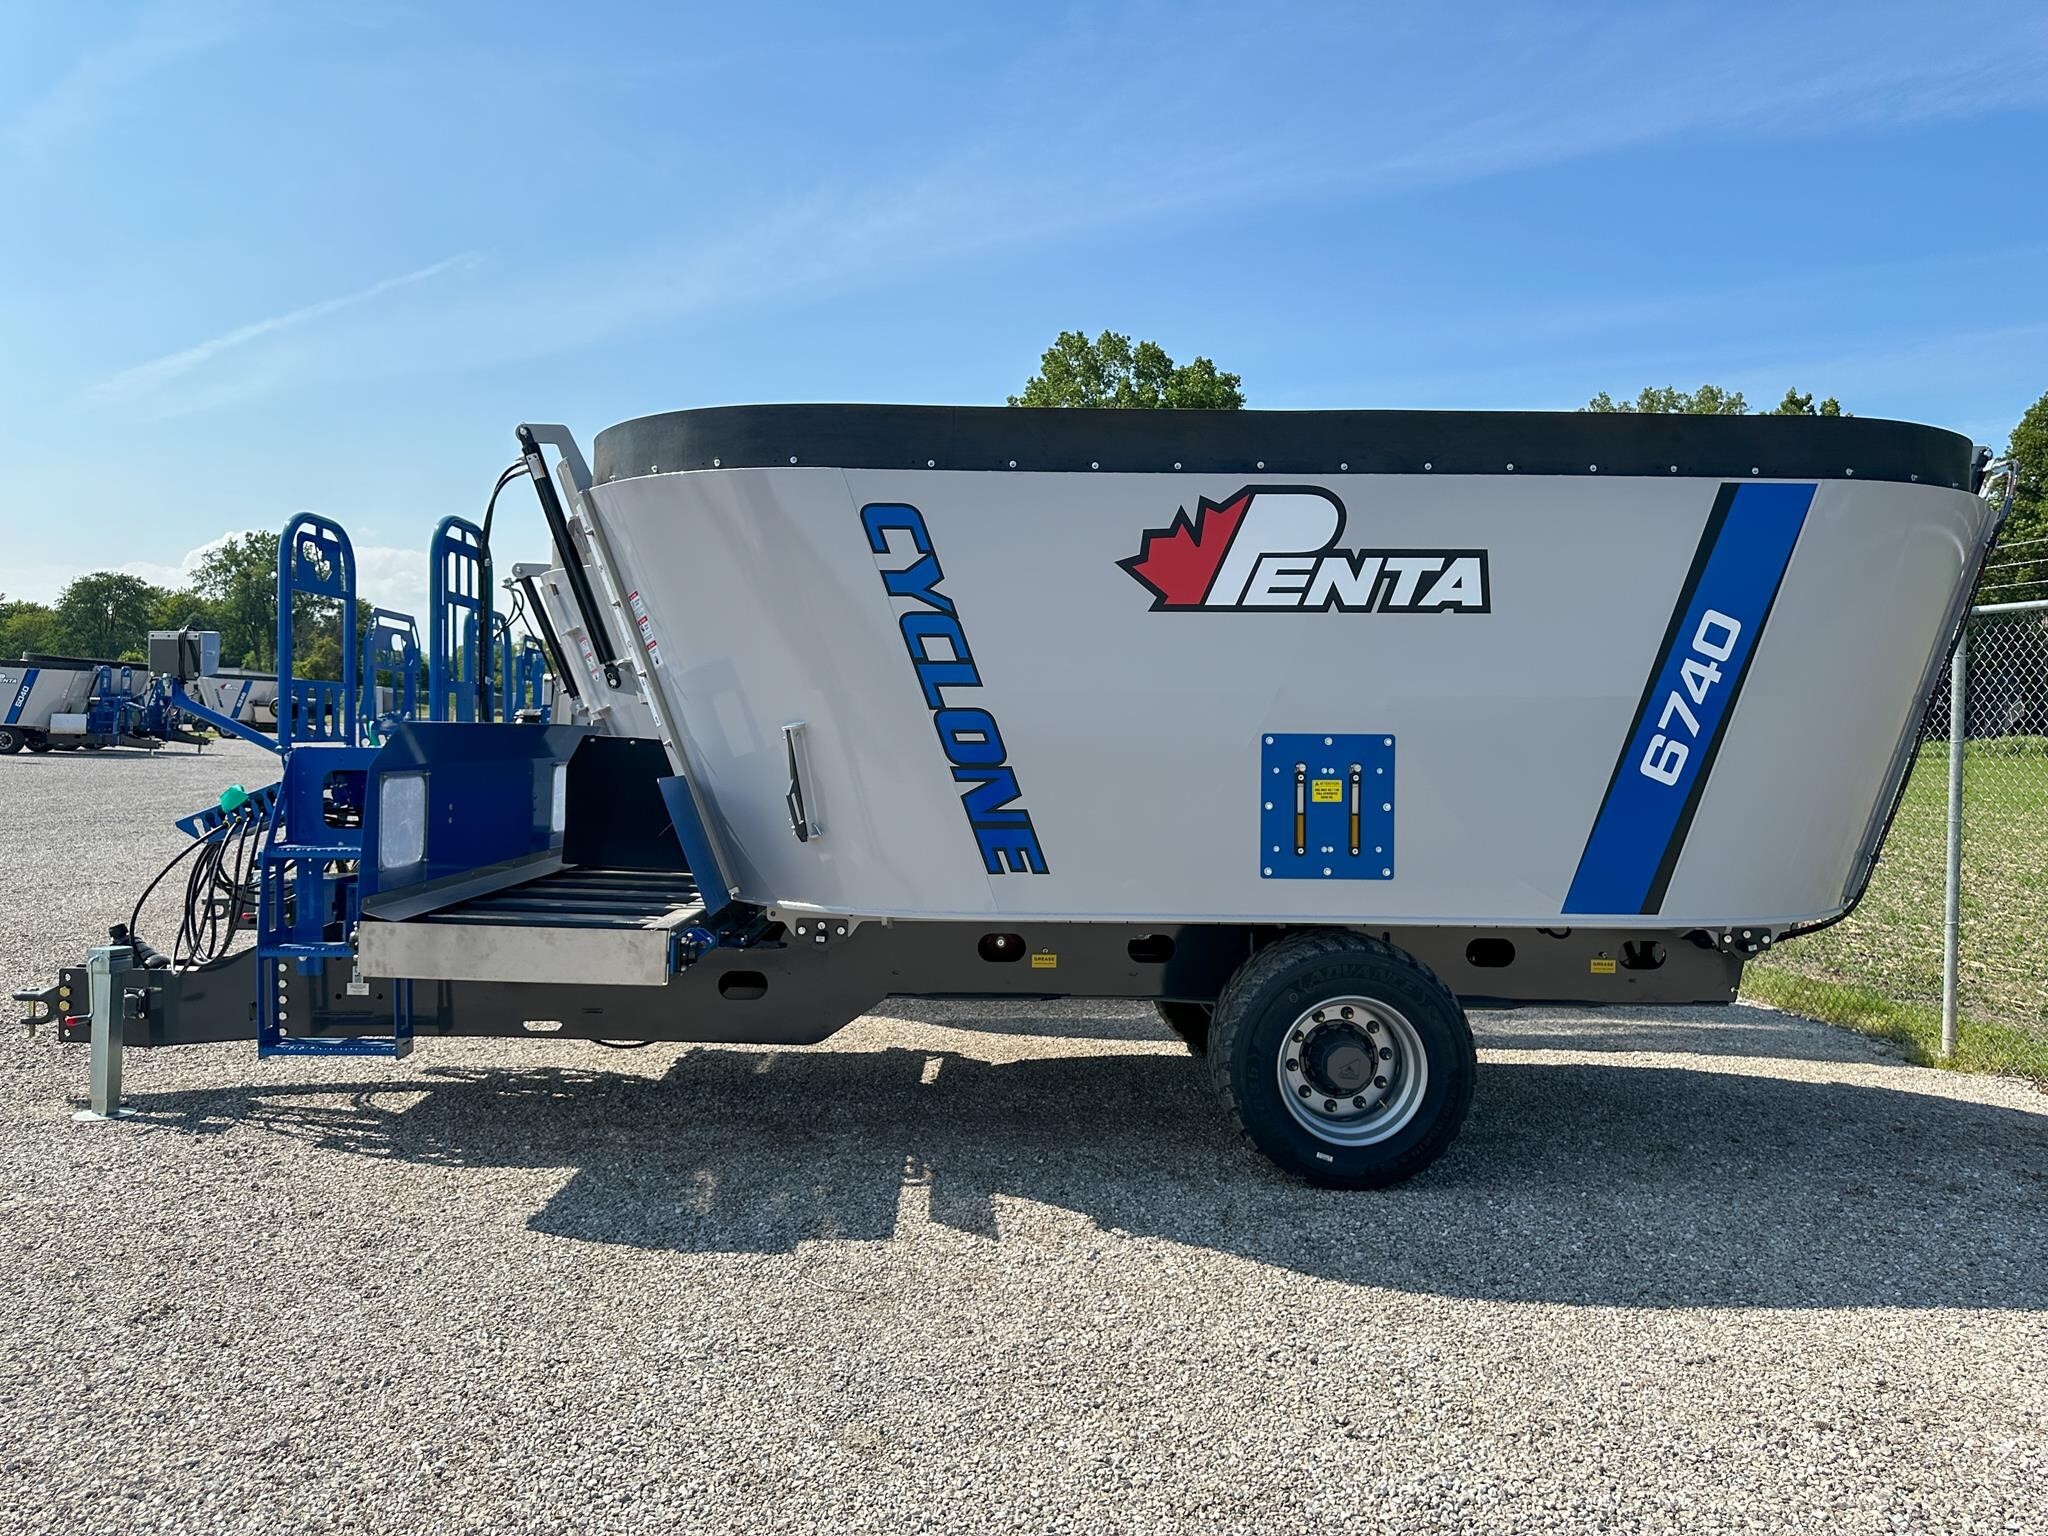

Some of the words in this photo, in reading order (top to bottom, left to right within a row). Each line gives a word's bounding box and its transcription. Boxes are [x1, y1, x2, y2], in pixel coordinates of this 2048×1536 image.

[1203, 490, 1485, 608] PENTA
[15, 685, 30, 708] 5040
[860, 502, 1050, 875] CYCLONE
[1639, 608, 1742, 787] 6740
